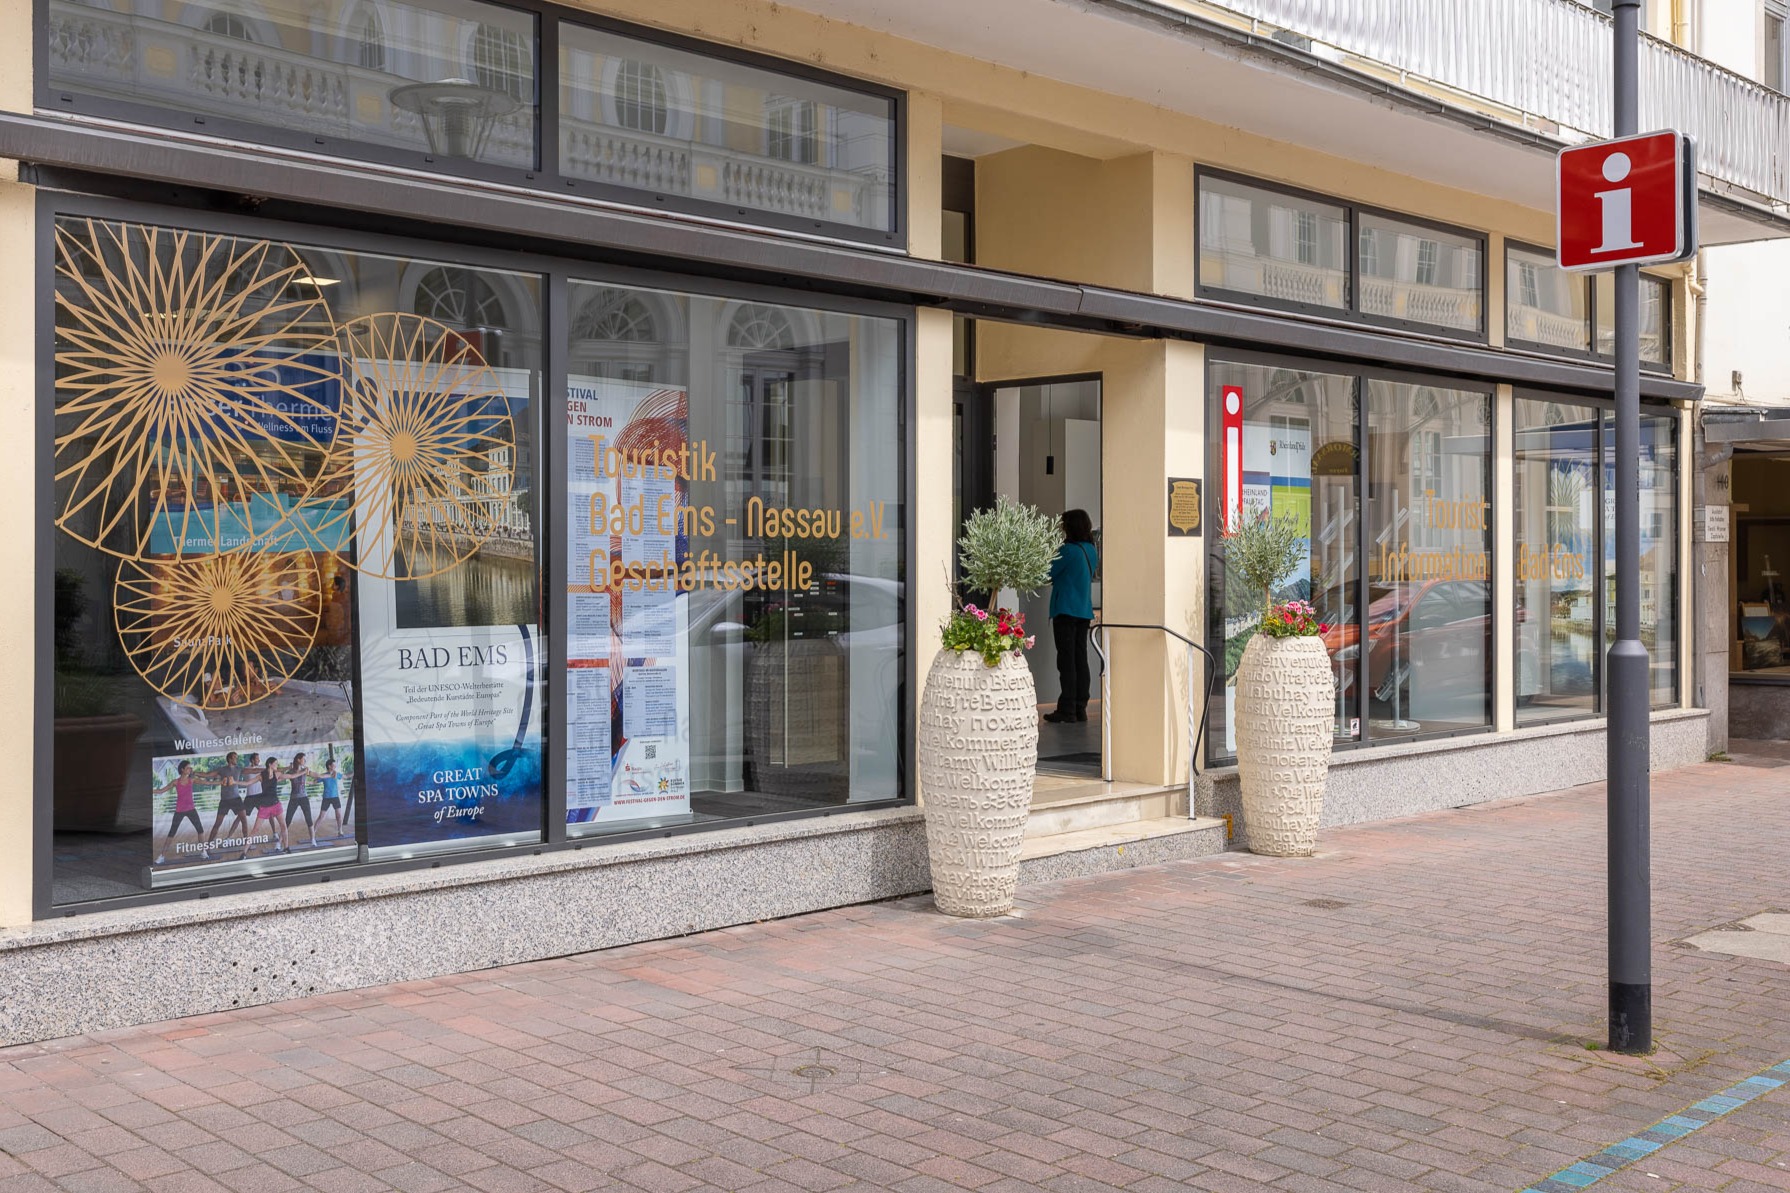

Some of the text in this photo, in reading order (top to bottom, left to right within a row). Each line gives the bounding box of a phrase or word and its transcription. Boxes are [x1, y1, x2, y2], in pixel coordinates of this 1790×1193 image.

[311, 423, 333, 434] Fluss
[577, 415, 612, 428] STROM
[588, 434, 716, 481] Touristik
[590, 492, 644, 537] Bad
[657, 494, 715, 537] Ems
[748, 496, 841, 539] Nassau
[851, 500, 888, 539] e.V.
[1425, 489, 1487, 531] Tourist
[589, 548, 812, 592] Geschäftsstelle
[1381, 542, 1487, 582] Information
[1520, 543, 1585, 581] Bad Ems
[398, 644, 507, 669] BAD EMS
[403, 681, 504, 693] Teil der UNESCO-Welterbestätte
[446, 692, 474, 701] Kurstädte
[396, 713, 429, 723] Component
[430, 711, 443, 720] Part
[444, 710, 452, 720] of
[451, 710, 459, 718] the
[461, 709, 477, 717] World
[478, 708, 502, 718] Heritage
[435, 721, 446, 731] Spa
[448, 720, 466, 728] Towns
[467, 719, 475, 728] of
[174, 733, 263, 750] WellnessGalerie
[433, 767, 483, 784] GREAT
[418, 783, 499, 804] SPA TOWNS
[434, 805, 485, 823] of Europe
[176, 834, 269, 854] FitnessPanorama
